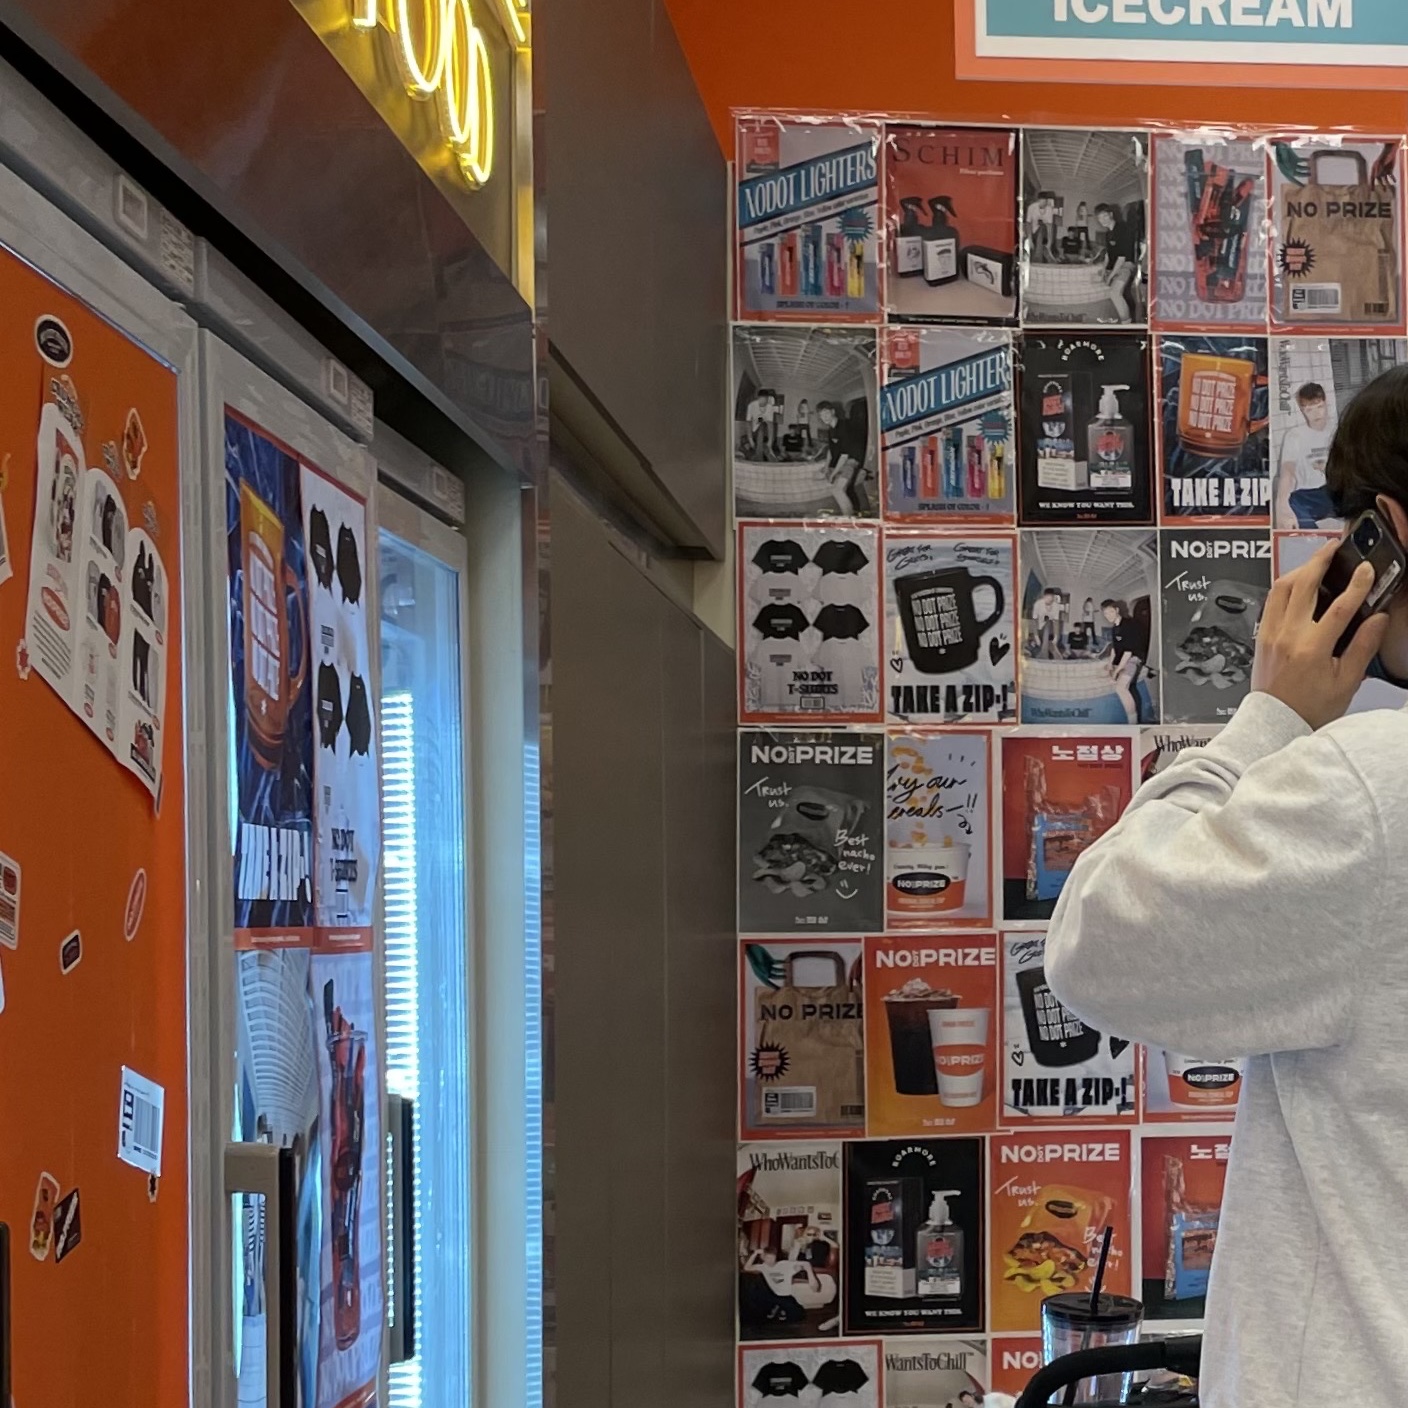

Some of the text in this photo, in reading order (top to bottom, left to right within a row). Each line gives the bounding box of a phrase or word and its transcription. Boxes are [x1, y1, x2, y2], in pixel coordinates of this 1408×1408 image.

[1053, 0, 1353, 28] ICECREAM
[892, 138, 1004, 167] SCHIM
[800, 149, 877, 202] LIGHTERS
[1287, 201, 1391, 218] NO PRIZE
[1171, 478, 1271, 506] TAKE A ZIP
[1170, 541, 1206, 559] NO
[792, 671, 834, 682] NO DOT
[891, 685, 940, 713] TAKE
[945, 685, 959, 713] A
[751, 746, 788, 764] NO
[795, 746, 873, 764] PRIZE
[1051, 745, 1125, 762] 노점상
[833, 829, 870, 847] Best
[837, 860, 871, 875] ever!
[876, 950, 913, 968] NO
[919, 948, 996, 967] PRIZE
[761, 1004, 863, 1020] NO PRIZE
[1187, 1073, 1235, 1082] NO PRIZE
[1011, 1078, 1060, 1106] TAKE
[1064, 1078, 1077, 1105] A
[1001, 1145, 1038, 1163] NO
[1044, 1143, 1120, 1163] PRIZE
[1082, 1226, 1117, 1244] Bet
[865, 1309, 877, 1317] WE
[878, 1309, 902, 1317] KNOW
[903, 1309, 920, 1317] YOU
[921, 1309, 943, 1317] WANT
[1002, 1351, 1038, 1369] NO
